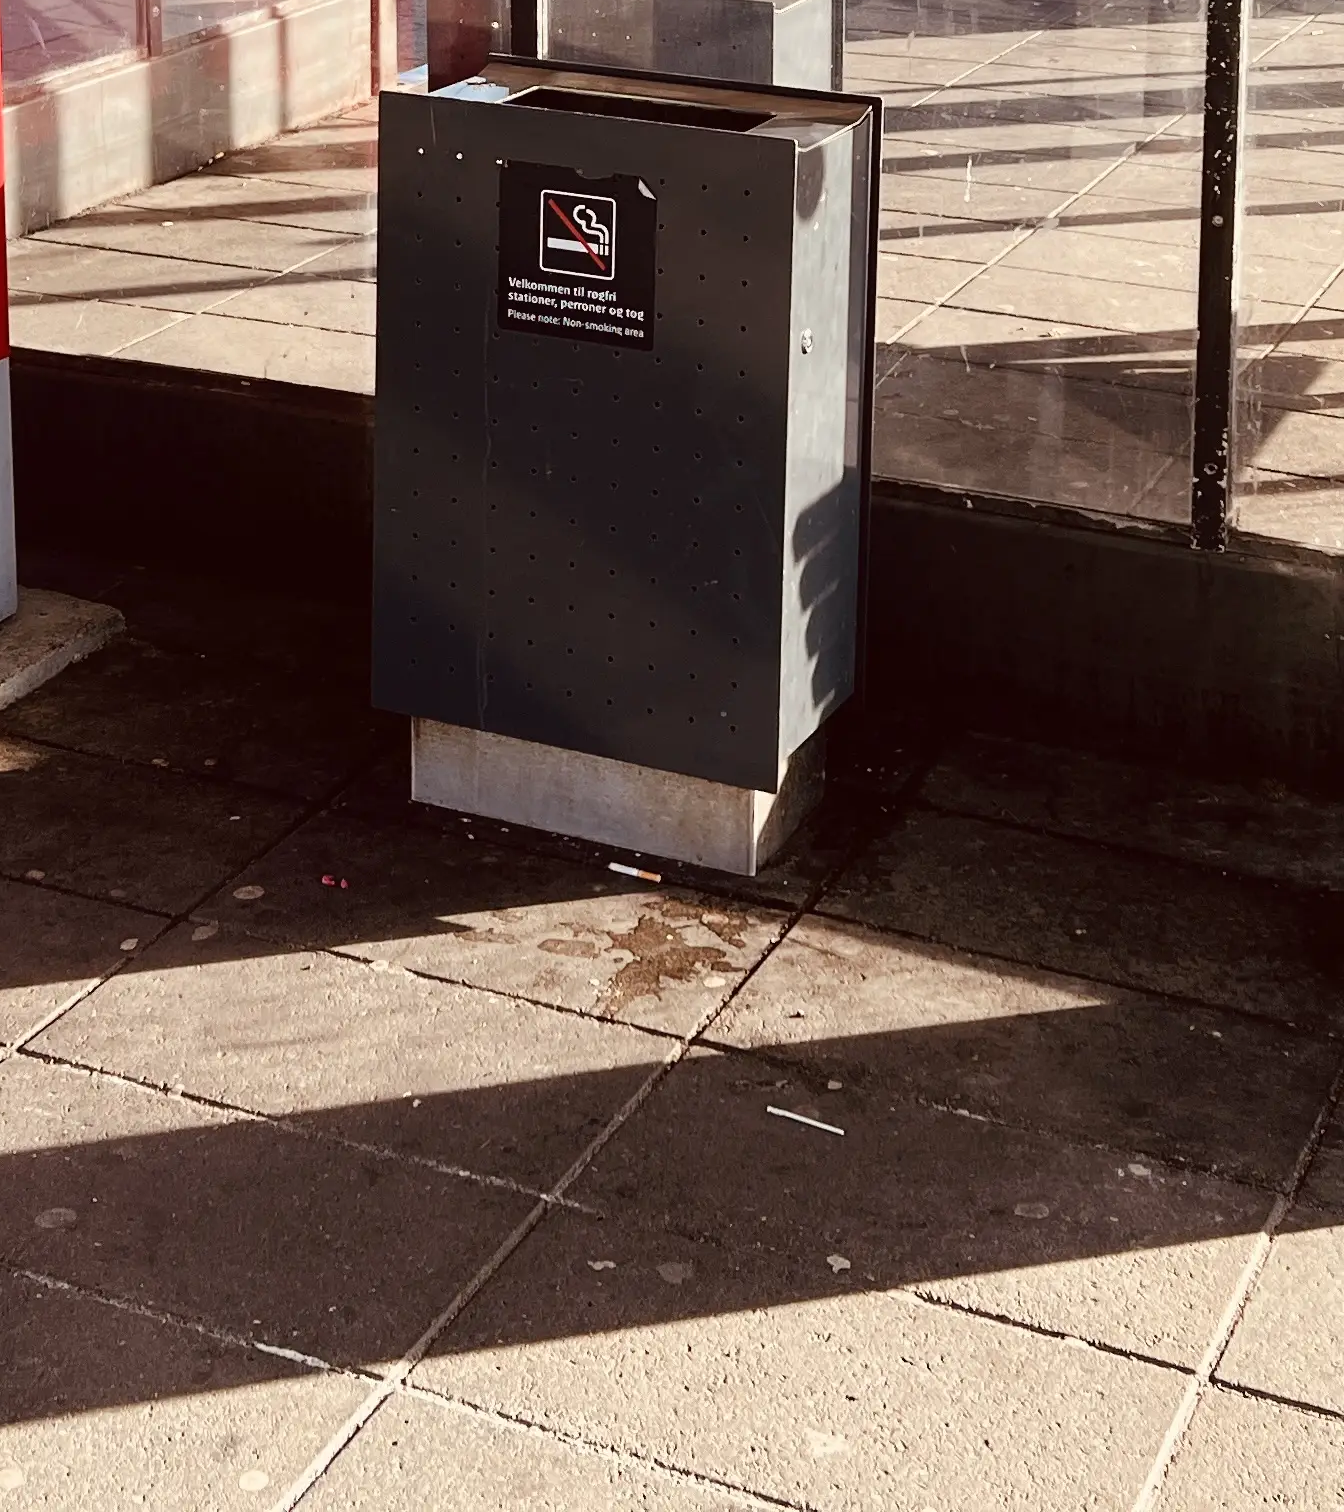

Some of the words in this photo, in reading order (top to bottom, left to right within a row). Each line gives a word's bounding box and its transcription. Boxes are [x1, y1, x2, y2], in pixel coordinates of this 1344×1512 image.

[508, 276, 570, 296] Velkommen
[573, 286, 584, 297] til
[508, 292, 558, 308] stationer,
[560, 299, 606, 314] perroner
[609, 307, 623, 318] og
[626, 308, 644, 321] tog
[507, 308, 536, 321] Please
[538, 314, 560, 325] note:
[562, 316, 622, 336] Non-smoking
[624, 328, 644, 338] area
